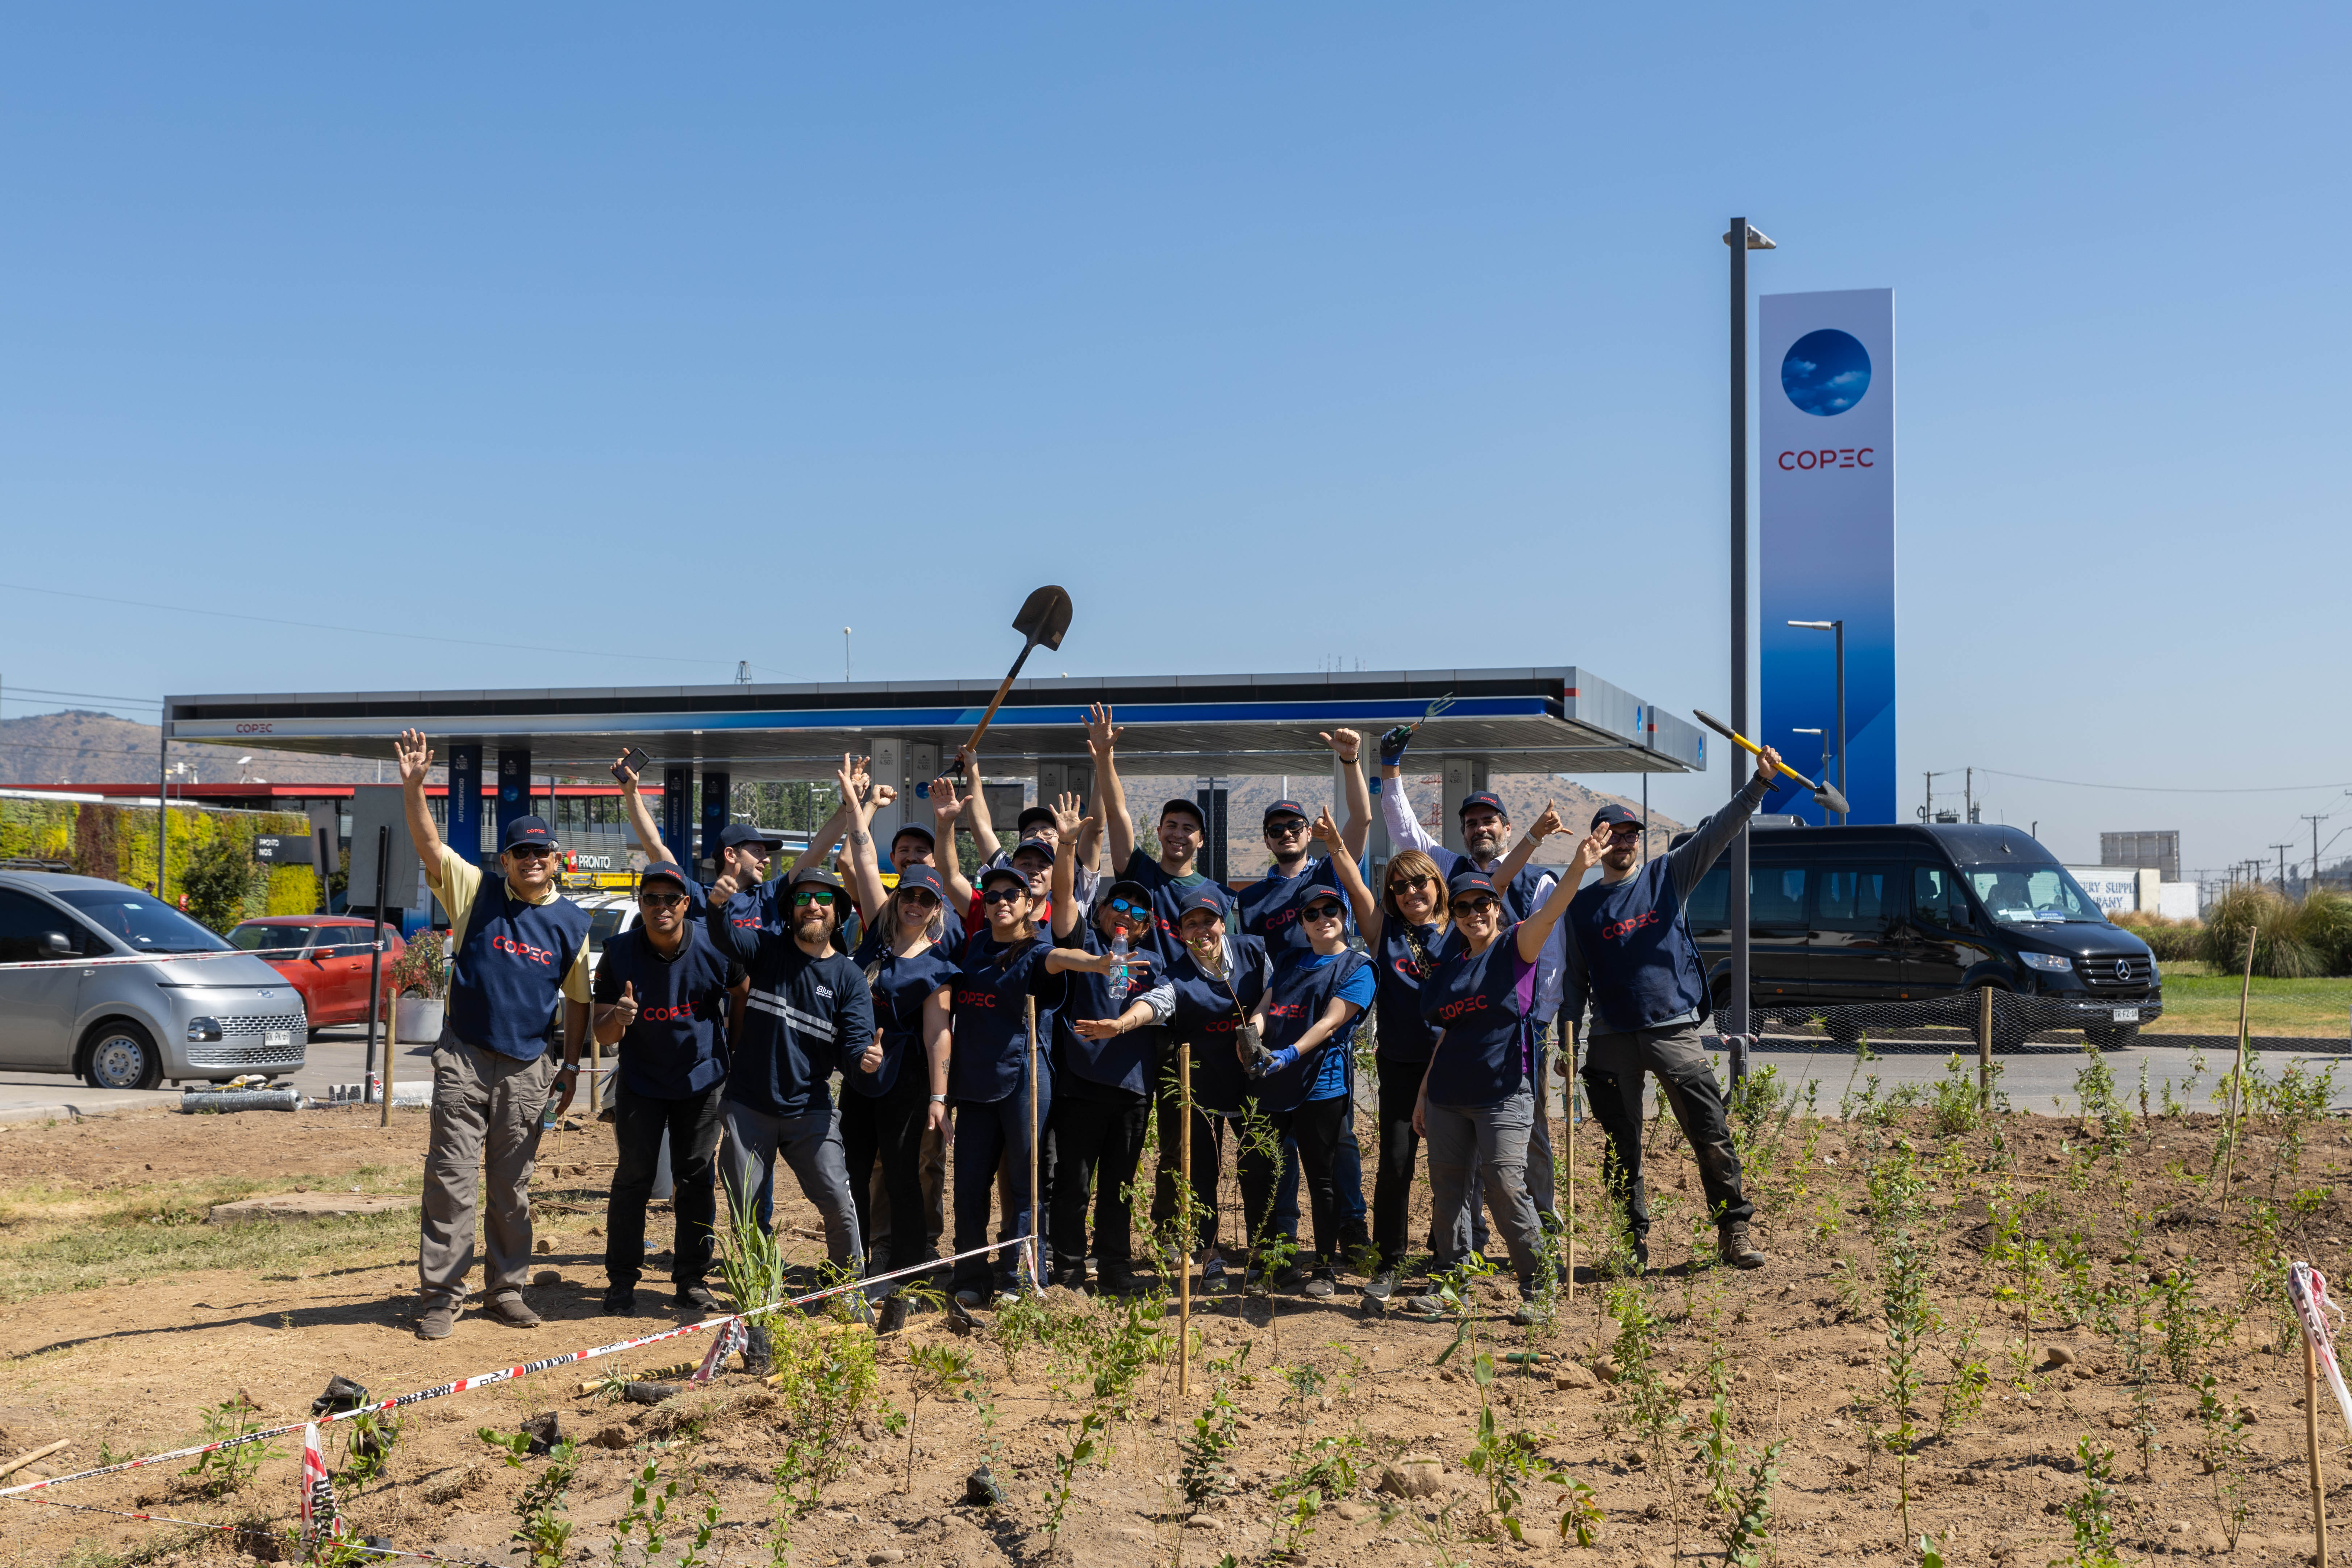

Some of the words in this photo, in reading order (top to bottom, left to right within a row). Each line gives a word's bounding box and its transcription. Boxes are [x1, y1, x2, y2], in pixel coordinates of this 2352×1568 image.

[1778, 448, 1873, 471] COPEC
[236, 723, 272, 733] COPEC
[579, 855, 610, 868] PRONTO
[926, 876, 940, 888] COPEC
[2106, 882, 2139, 894] SUPPLY
[1202, 898, 1217, 907] COPEC
[733, 916, 761, 929] PEC
[1265, 908, 1299, 930] COP
[1602, 910, 1659, 939] COPEC
[493, 935, 552, 965] COPEC
[817, 985, 833, 996] Blue
[958, 990, 996, 1008] OPEC
[643, 1001, 699, 1021] COPEC
[1268, 1002, 1307, 1018] OPEC
[1439, 995, 1488, 1020] COPEC
